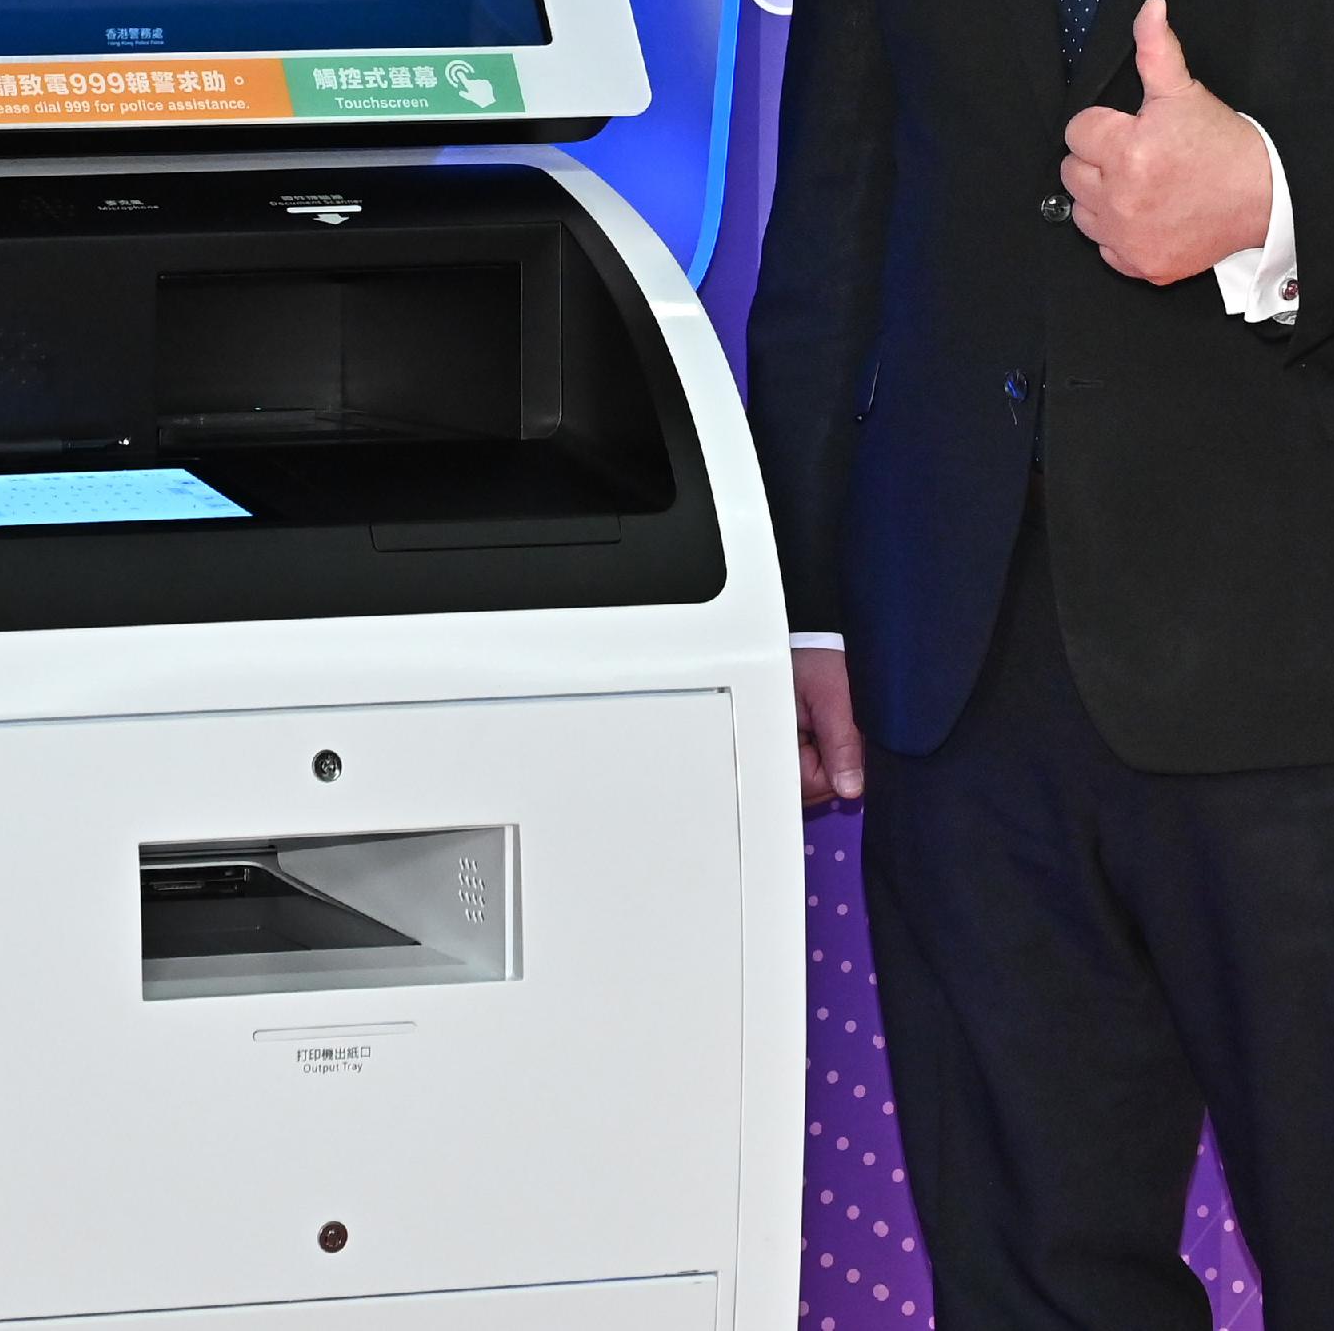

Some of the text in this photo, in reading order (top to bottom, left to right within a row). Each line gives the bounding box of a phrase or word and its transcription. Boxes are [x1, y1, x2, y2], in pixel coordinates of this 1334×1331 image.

[312, 65, 438, 90] 觸控式螢幕
[35, 101, 61, 114] dial
[65, 101, 91, 114] 999
[94, 100, 114, 113] for
[119, 99, 165, 115] police
[168, 98, 250, 112] assistance.
[335, 96, 429, 110] Touchscreen
[303, 1061, 363, 1074] Output Tray
